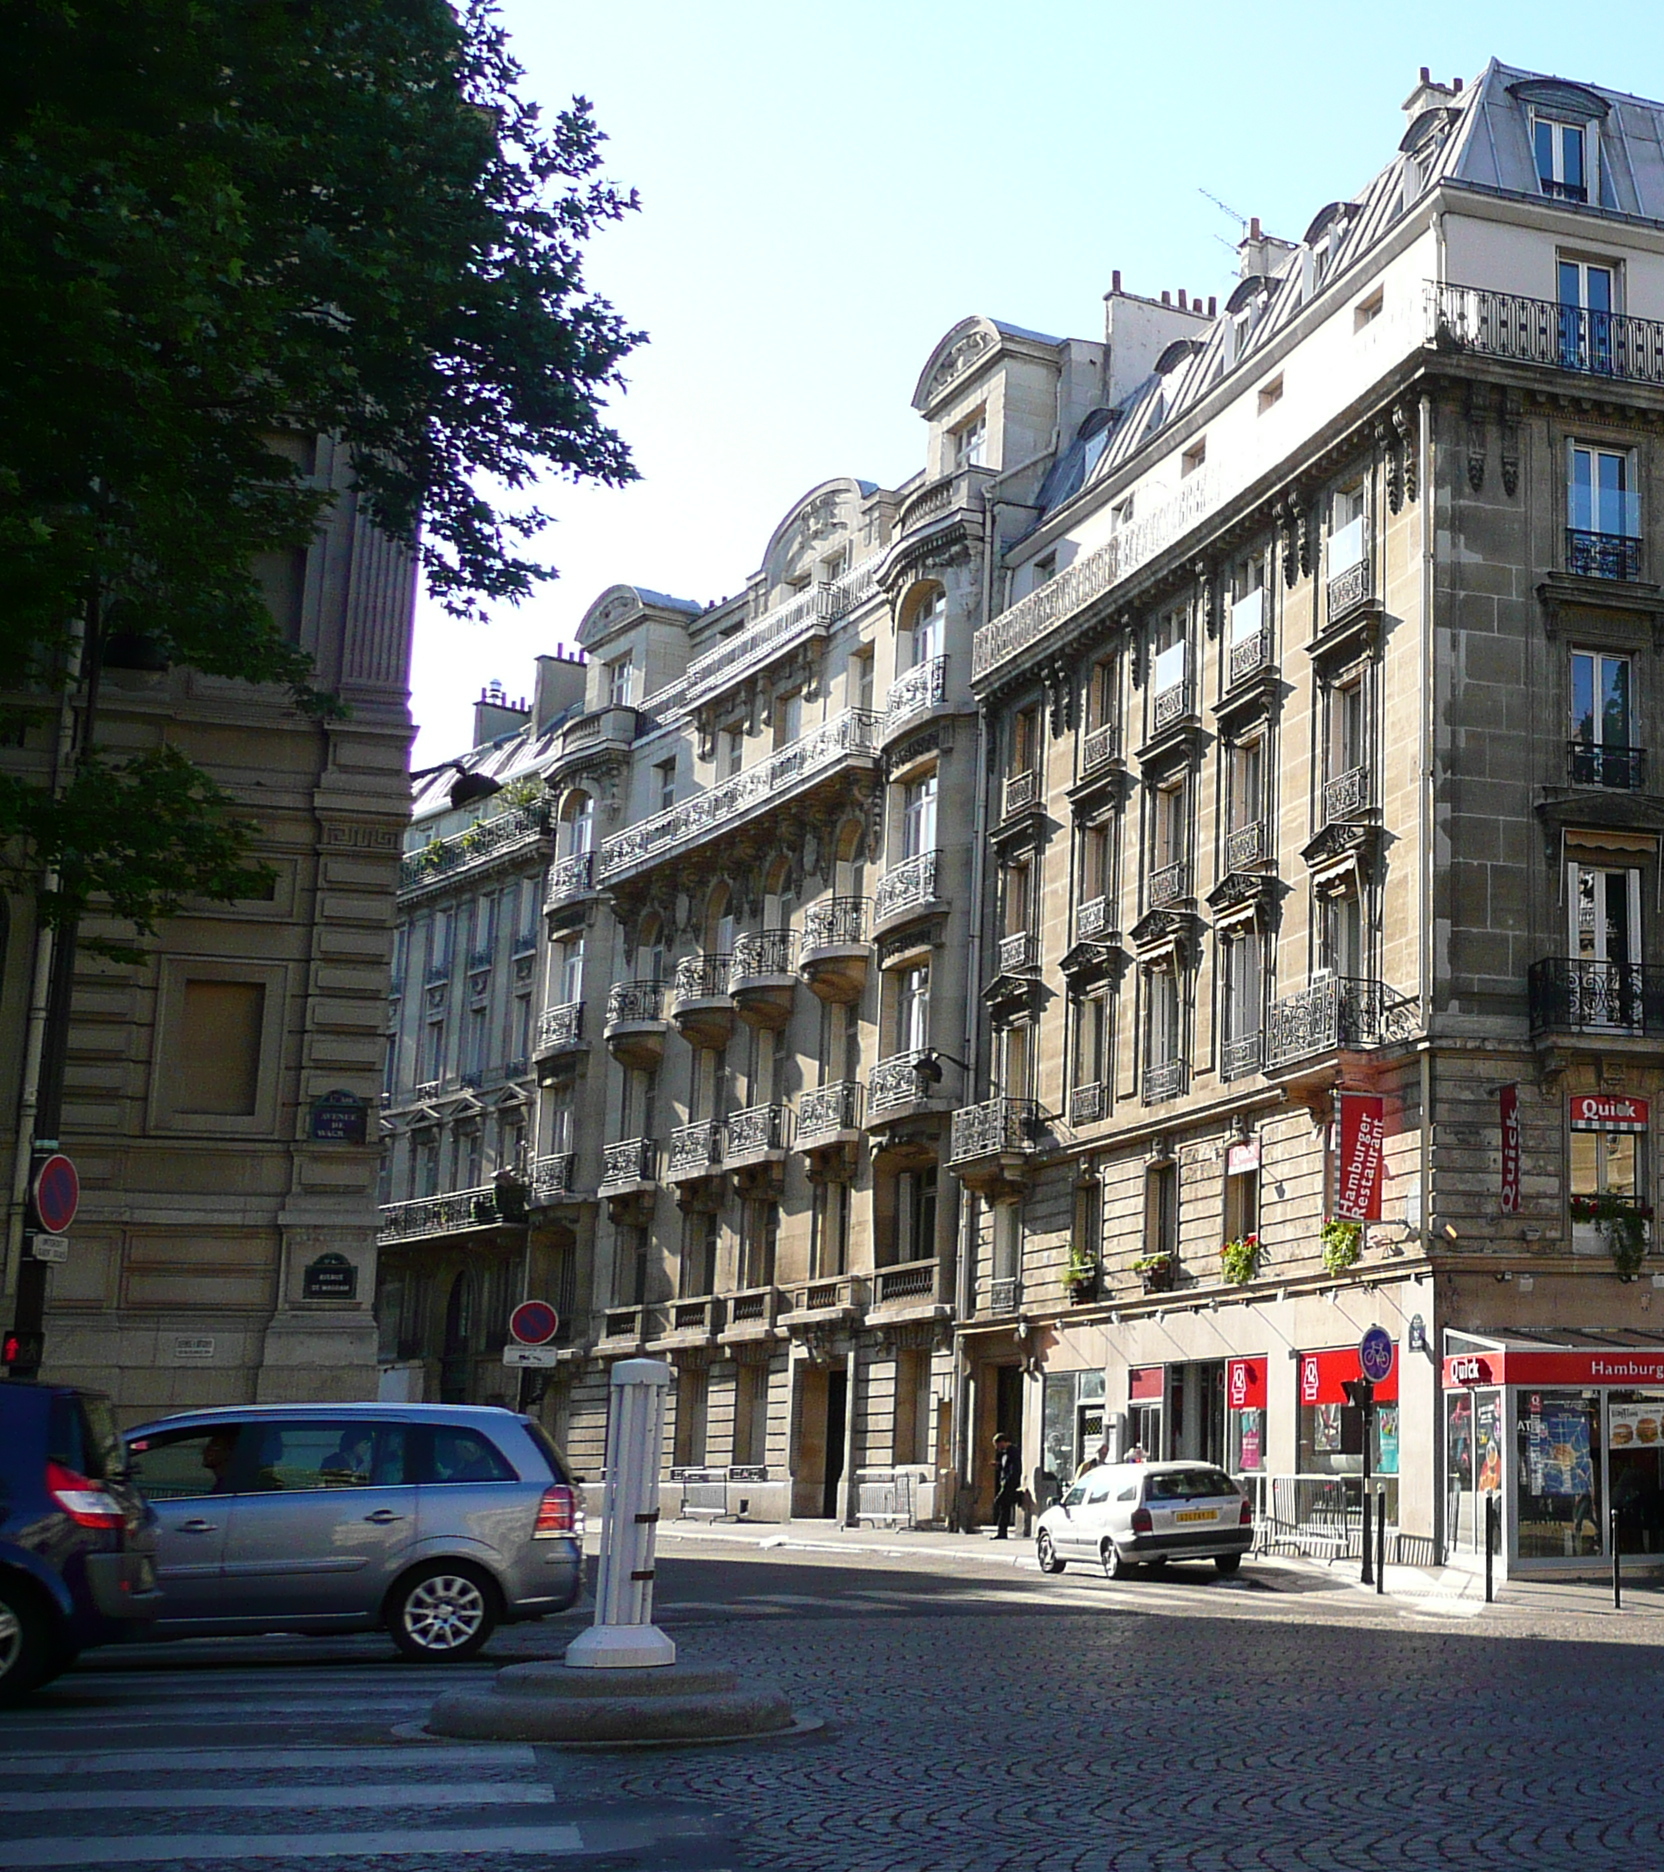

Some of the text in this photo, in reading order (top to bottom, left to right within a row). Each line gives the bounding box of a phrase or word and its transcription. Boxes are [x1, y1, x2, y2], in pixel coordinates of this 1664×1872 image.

[1582, 1099, 1636, 1119] Quik
[1339, 1112, 1372, 1217] Hamburger
[1351, 1117, 1384, 1221] Restaurant
[1502, 1108, 1517, 1213] Quick
[1450, 1357, 1480, 1384] Quick
[1531, 1395, 1540, 1407] Q
